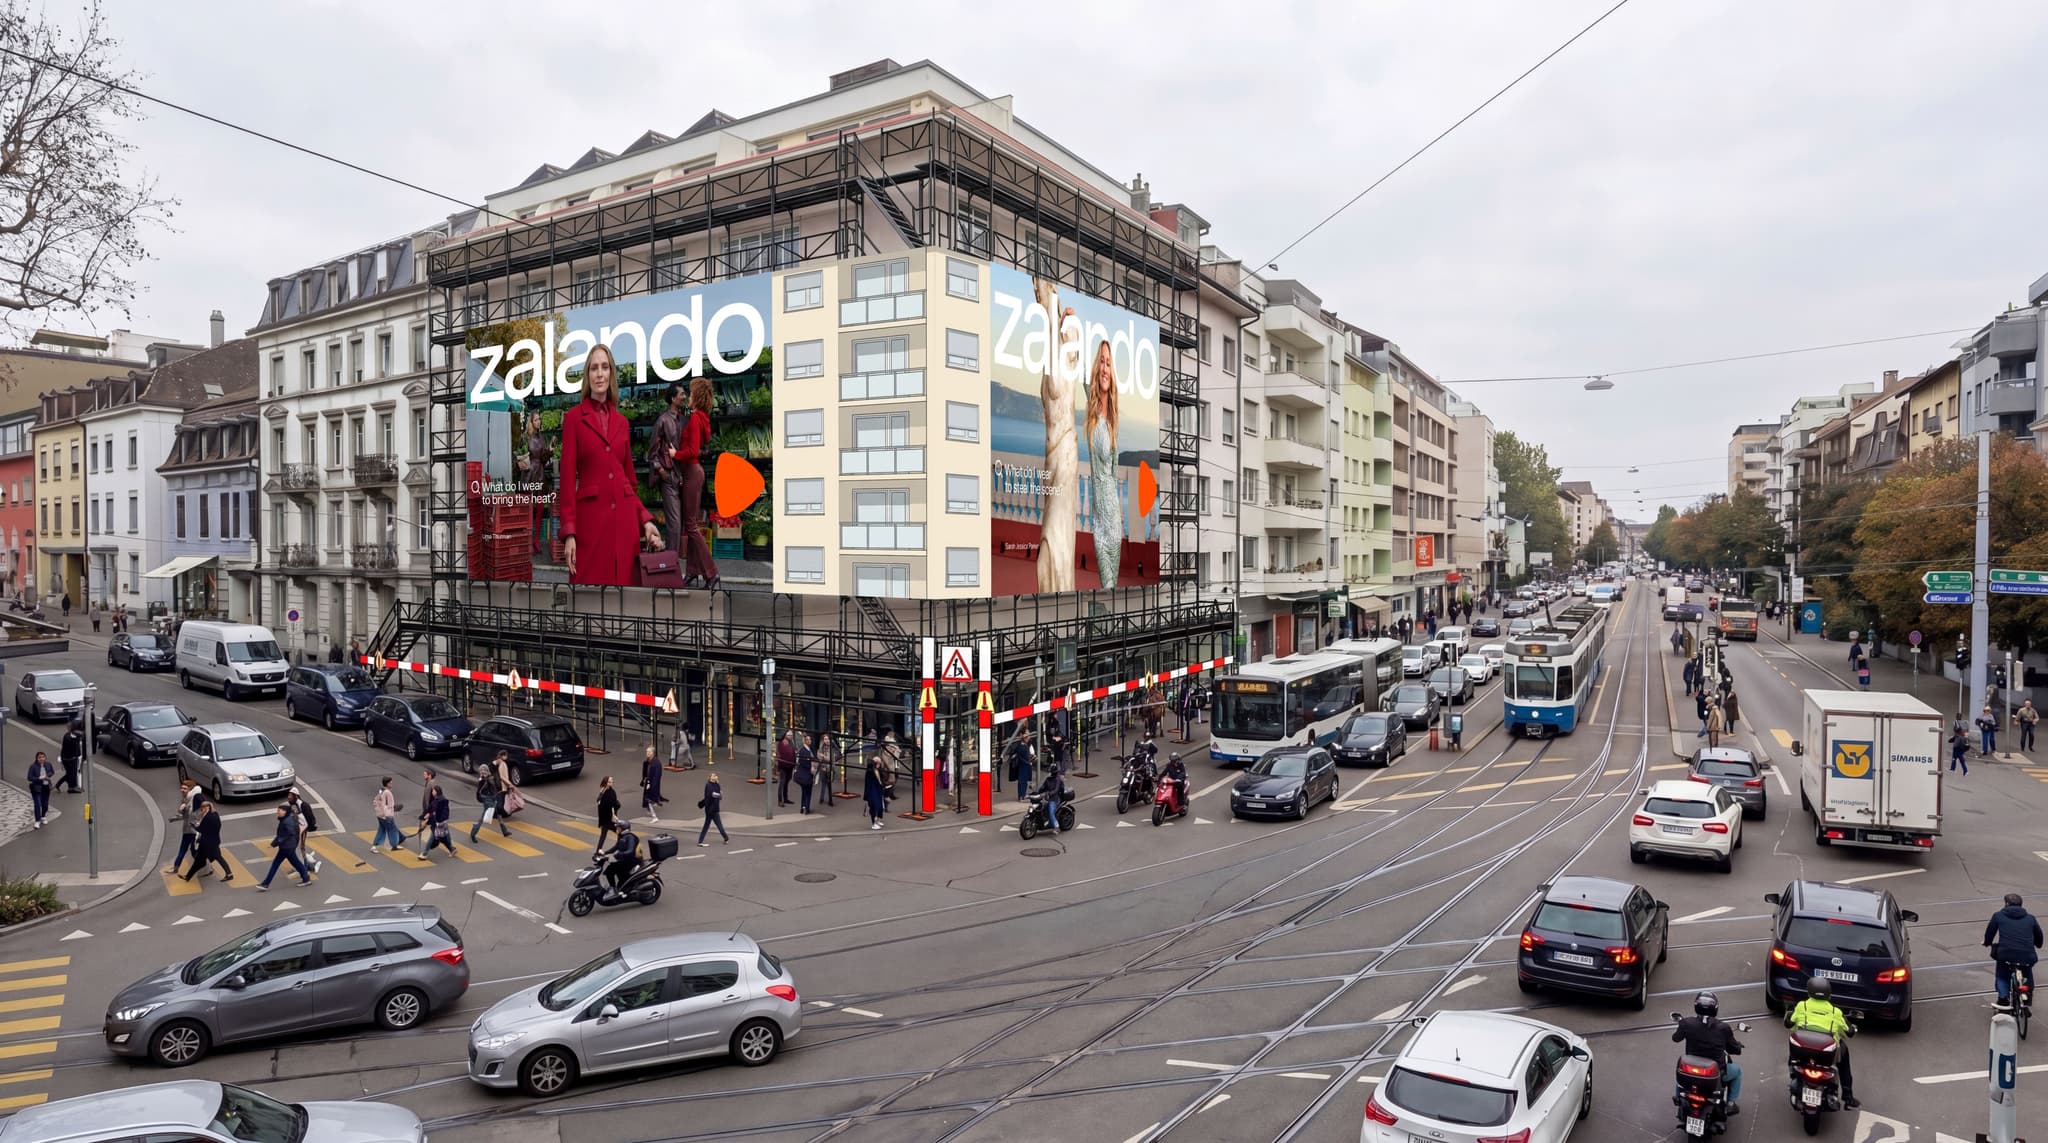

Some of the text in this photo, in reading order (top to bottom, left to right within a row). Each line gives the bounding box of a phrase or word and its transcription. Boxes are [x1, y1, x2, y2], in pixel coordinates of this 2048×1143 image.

[470, 294, 765, 404] zalando
[994, 291, 1157, 400] zalando
[1004, 463, 1023, 478] What
[1023, 466, 1033, 479] do
[1037, 469, 1052, 480] wear
[482, 481, 503, 492] What
[505, 480, 516, 491] do
[522, 481, 544, 491] wear
[1005, 482, 1012, 494] to
[1013, 482, 1028, 494] steal
[1030, 482, 1040, 495] the
[482, 492, 557, 507] to bring the heat?
